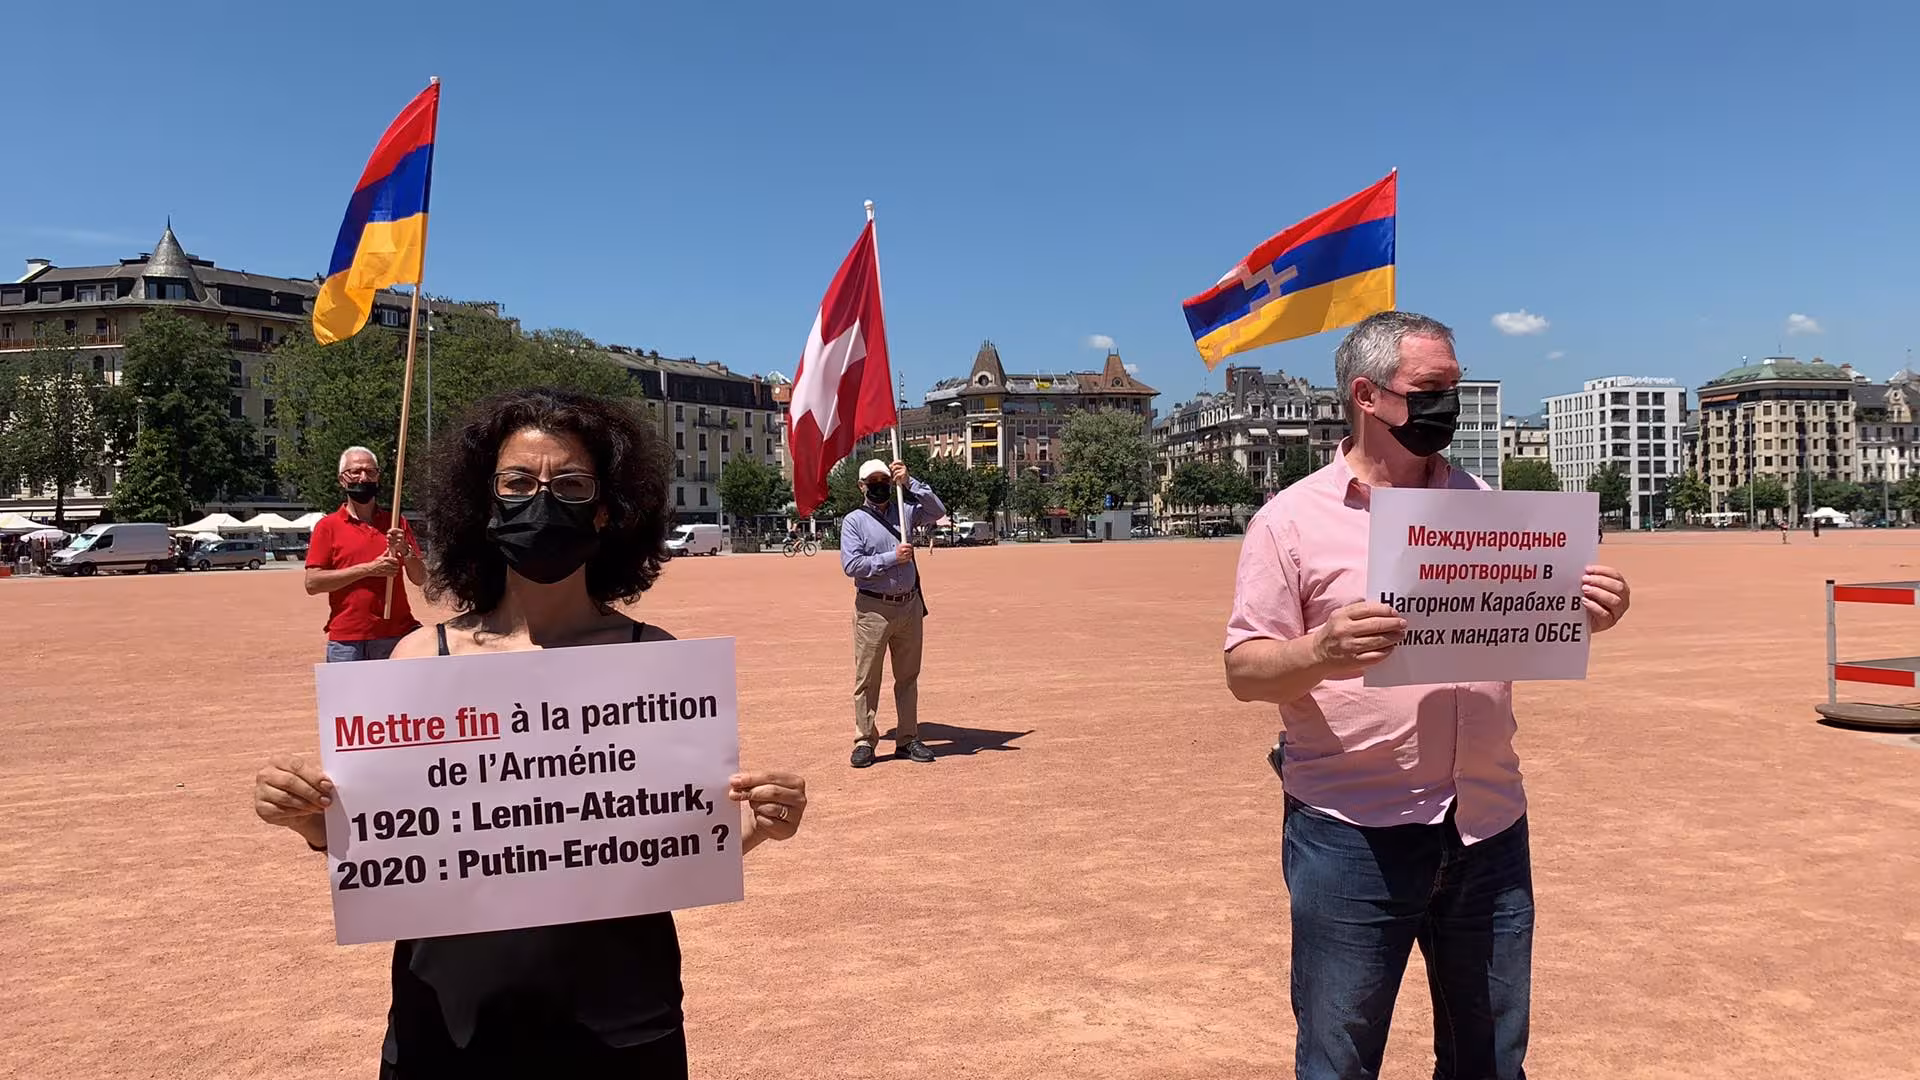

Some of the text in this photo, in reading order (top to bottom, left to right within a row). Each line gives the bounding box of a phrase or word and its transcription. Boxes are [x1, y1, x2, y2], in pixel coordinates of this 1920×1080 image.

[1408, 525, 1567, 551] Международные
[1419, 563, 1553, 585] миротворцы в
[1380, 591, 1581, 617] Нагорном Карабахе в
[1394, 622, 1583, 647] мках мандата ОБСЕ
[335, 691, 717, 747] Mettre fin à la partition
[427, 757, 467, 788] de
[351, 783, 714, 842] 1920 : Lenin-Ataturk,
[337, 823, 730, 891] 2020 : Putin-Erdogan ?
